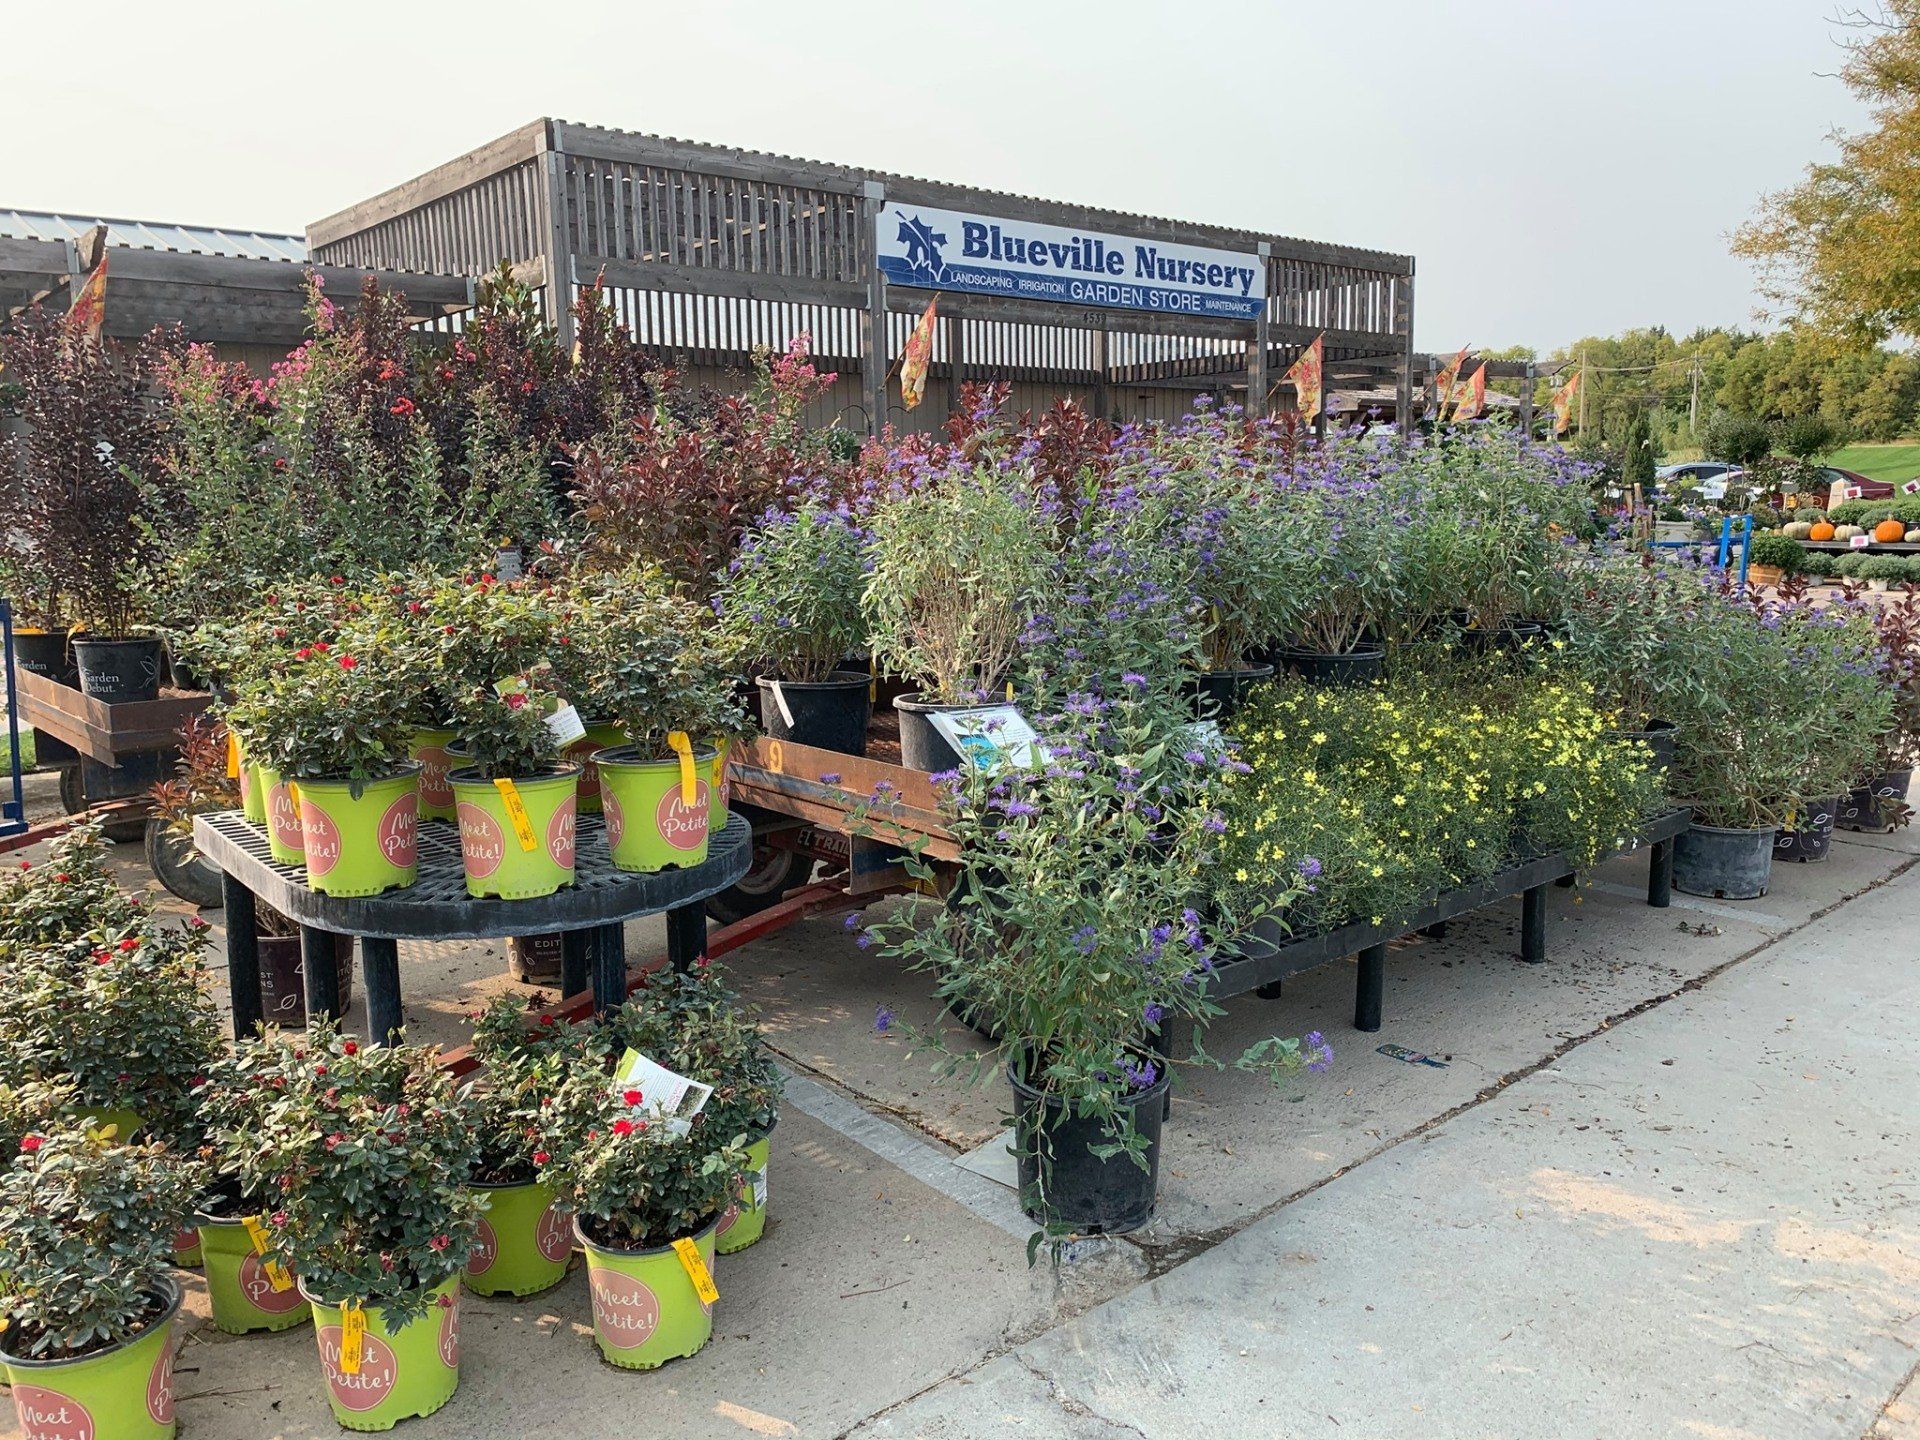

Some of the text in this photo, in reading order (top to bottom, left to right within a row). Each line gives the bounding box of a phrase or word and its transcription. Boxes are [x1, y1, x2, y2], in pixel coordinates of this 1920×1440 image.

[962, 220, 1255, 297] Blueville Nursery
[951, 272, 1251, 313] LANDSCAPING IRRIGATION GARDEN STORE MAINTENANCE
[595, 1282, 643, 1307] Meet
[594, 1300, 653, 1330] Petite!
[324, 1361, 391, 1390] Petite!
[20, 1401, 73, 1427] Meet
